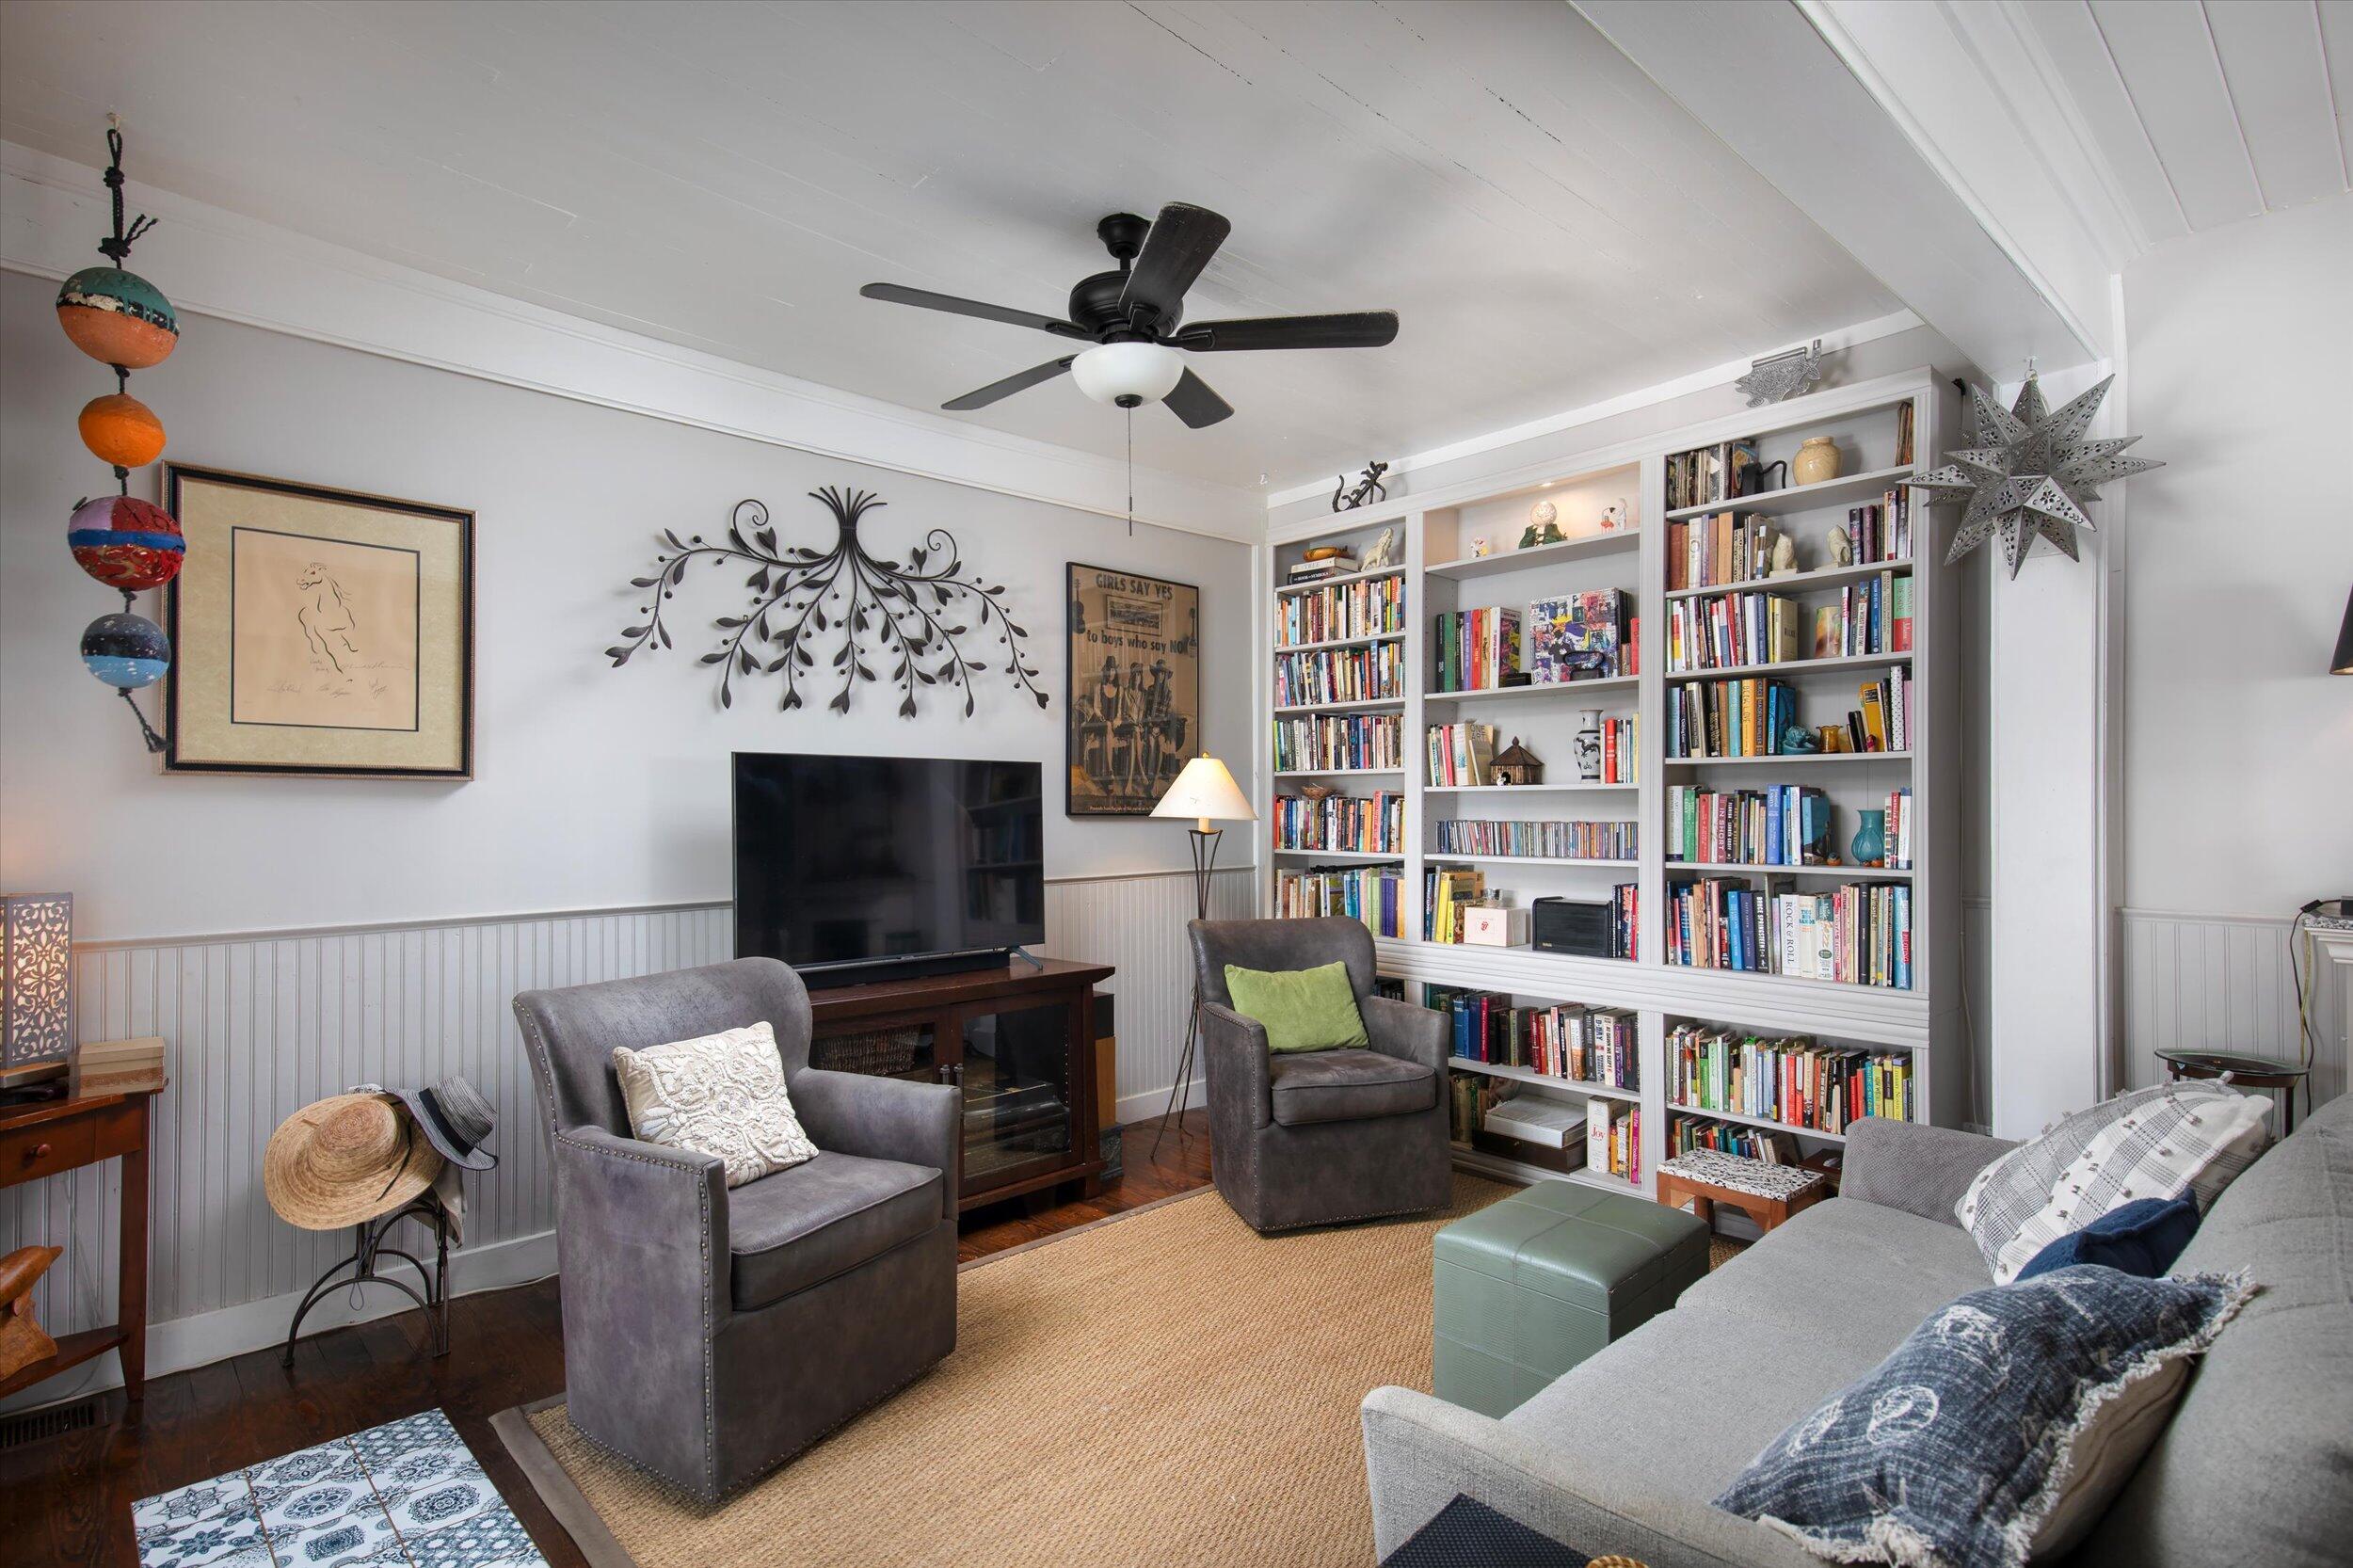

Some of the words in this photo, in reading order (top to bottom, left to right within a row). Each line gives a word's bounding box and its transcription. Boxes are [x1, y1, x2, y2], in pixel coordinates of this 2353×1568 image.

[1096, 573, 1127, 592] GIRLS
[1129, 579, 1151, 596] SAY
[1154, 585, 1174, 601] YES
[1086, 630, 1098, 644] to
[1101, 630, 1124, 648] boys
[1127, 634, 1148, 649] who
[1150, 641, 1167, 655] say
[1720, 808, 1724, 817] IN
